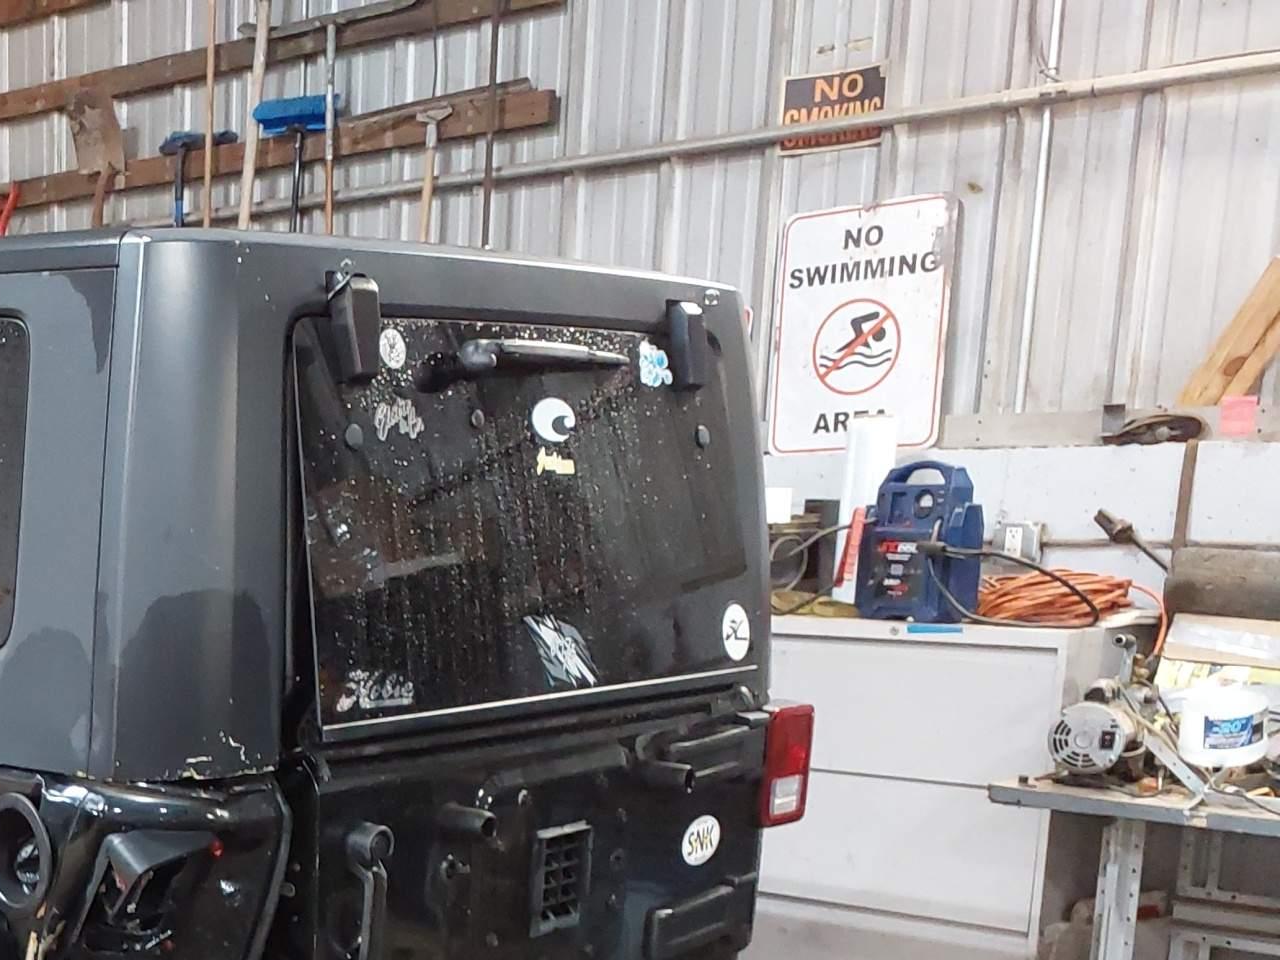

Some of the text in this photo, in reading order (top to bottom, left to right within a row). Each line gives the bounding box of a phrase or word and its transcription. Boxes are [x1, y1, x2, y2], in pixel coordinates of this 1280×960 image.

[814, 73, 864, 103] NO
[843, 225, 884, 250] NO
[789, 251, 938, 289] SWIMMING
[813, 409, 886, 434] AR
